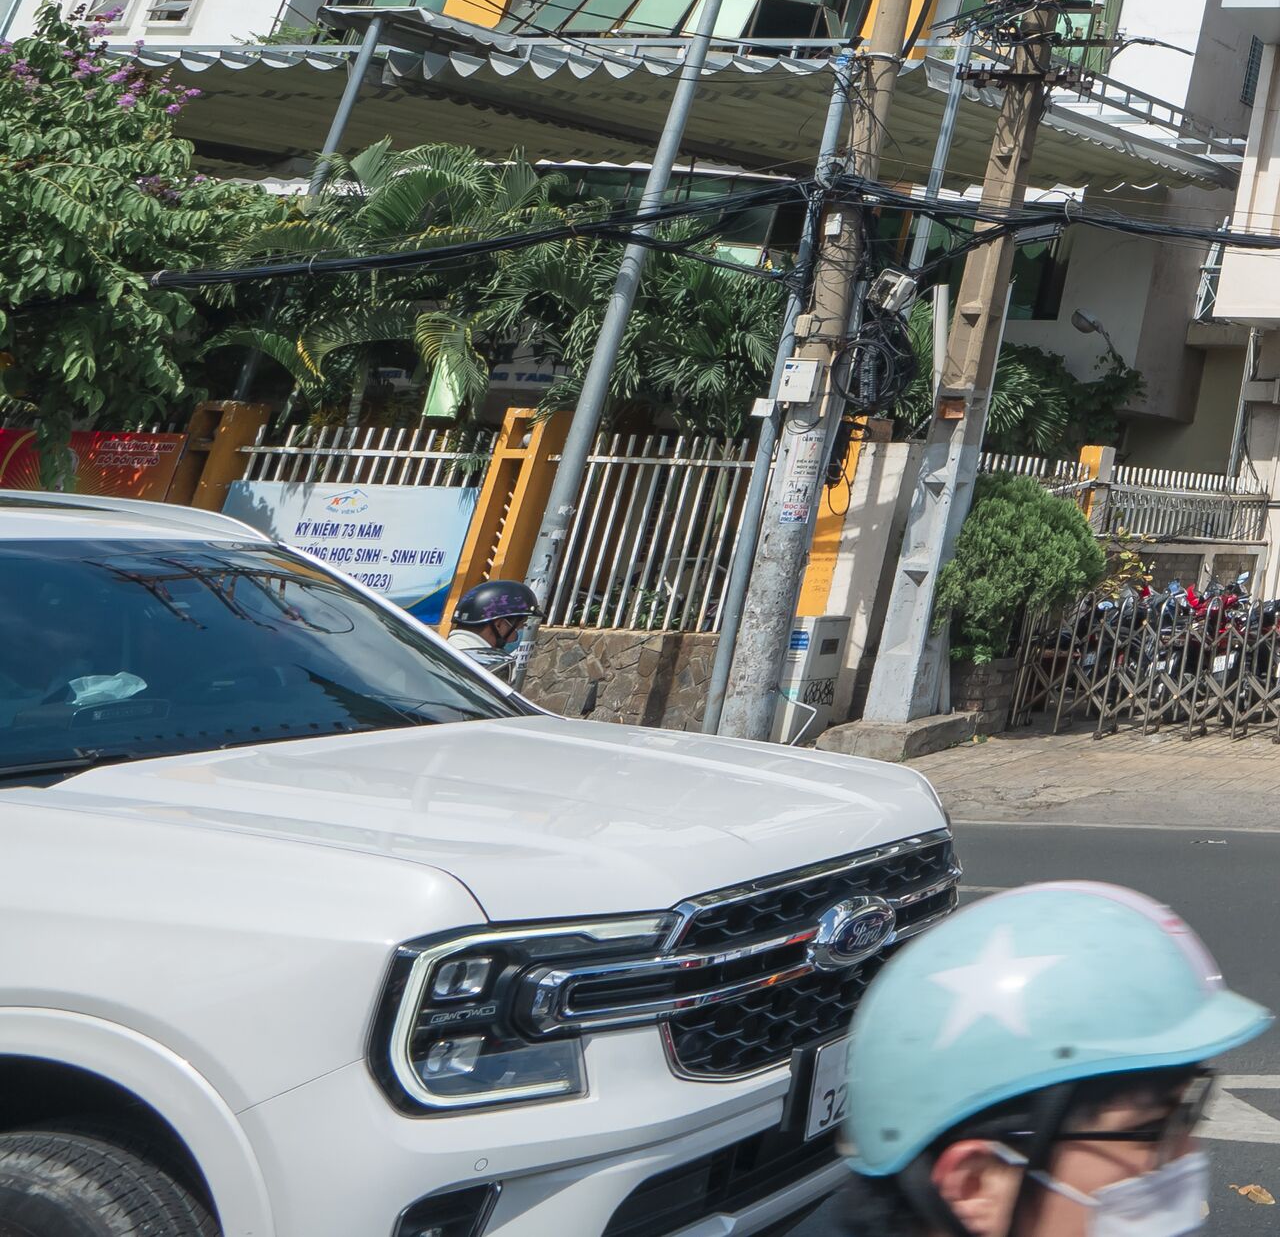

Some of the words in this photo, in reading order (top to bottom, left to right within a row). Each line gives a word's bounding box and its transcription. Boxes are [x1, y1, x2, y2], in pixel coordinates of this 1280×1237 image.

[295, 518, 310, 537] KỶ
[311, 519, 338, 539] NIỆM
[342, 523, 355, 537] 73
[357, 521, 383, 539] NĂM
[329, 547, 352, 566] HỌC
[355, 547, 381, 563] SINH
[390, 549, 417, 564] SINH
[419, 547, 445, 565] VIÊN
[848, 920, 884, 950] Ford
